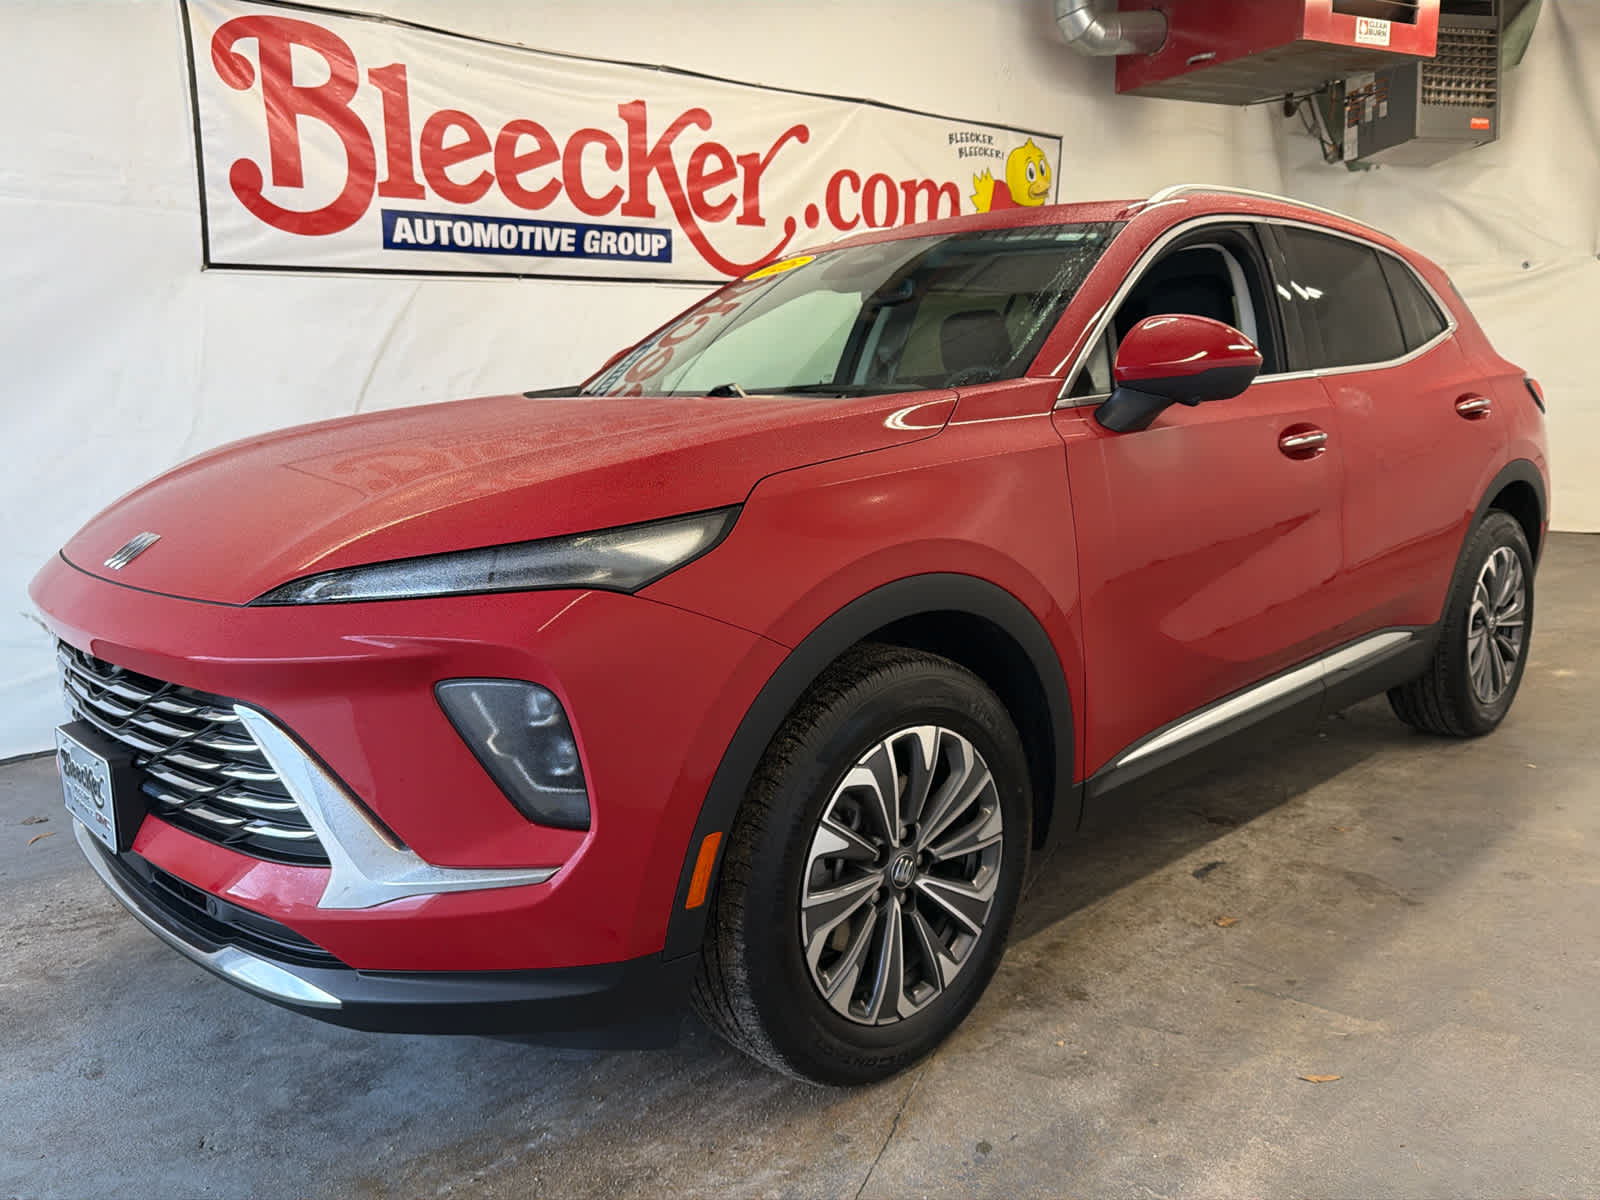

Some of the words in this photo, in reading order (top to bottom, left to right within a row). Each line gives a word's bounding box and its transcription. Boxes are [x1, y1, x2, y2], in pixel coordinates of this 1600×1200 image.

[392, 217, 576, 252] AUTOMOTIVE
[583, 230, 667, 256] GROUP
[60, 746, 105, 809] Bleecker
